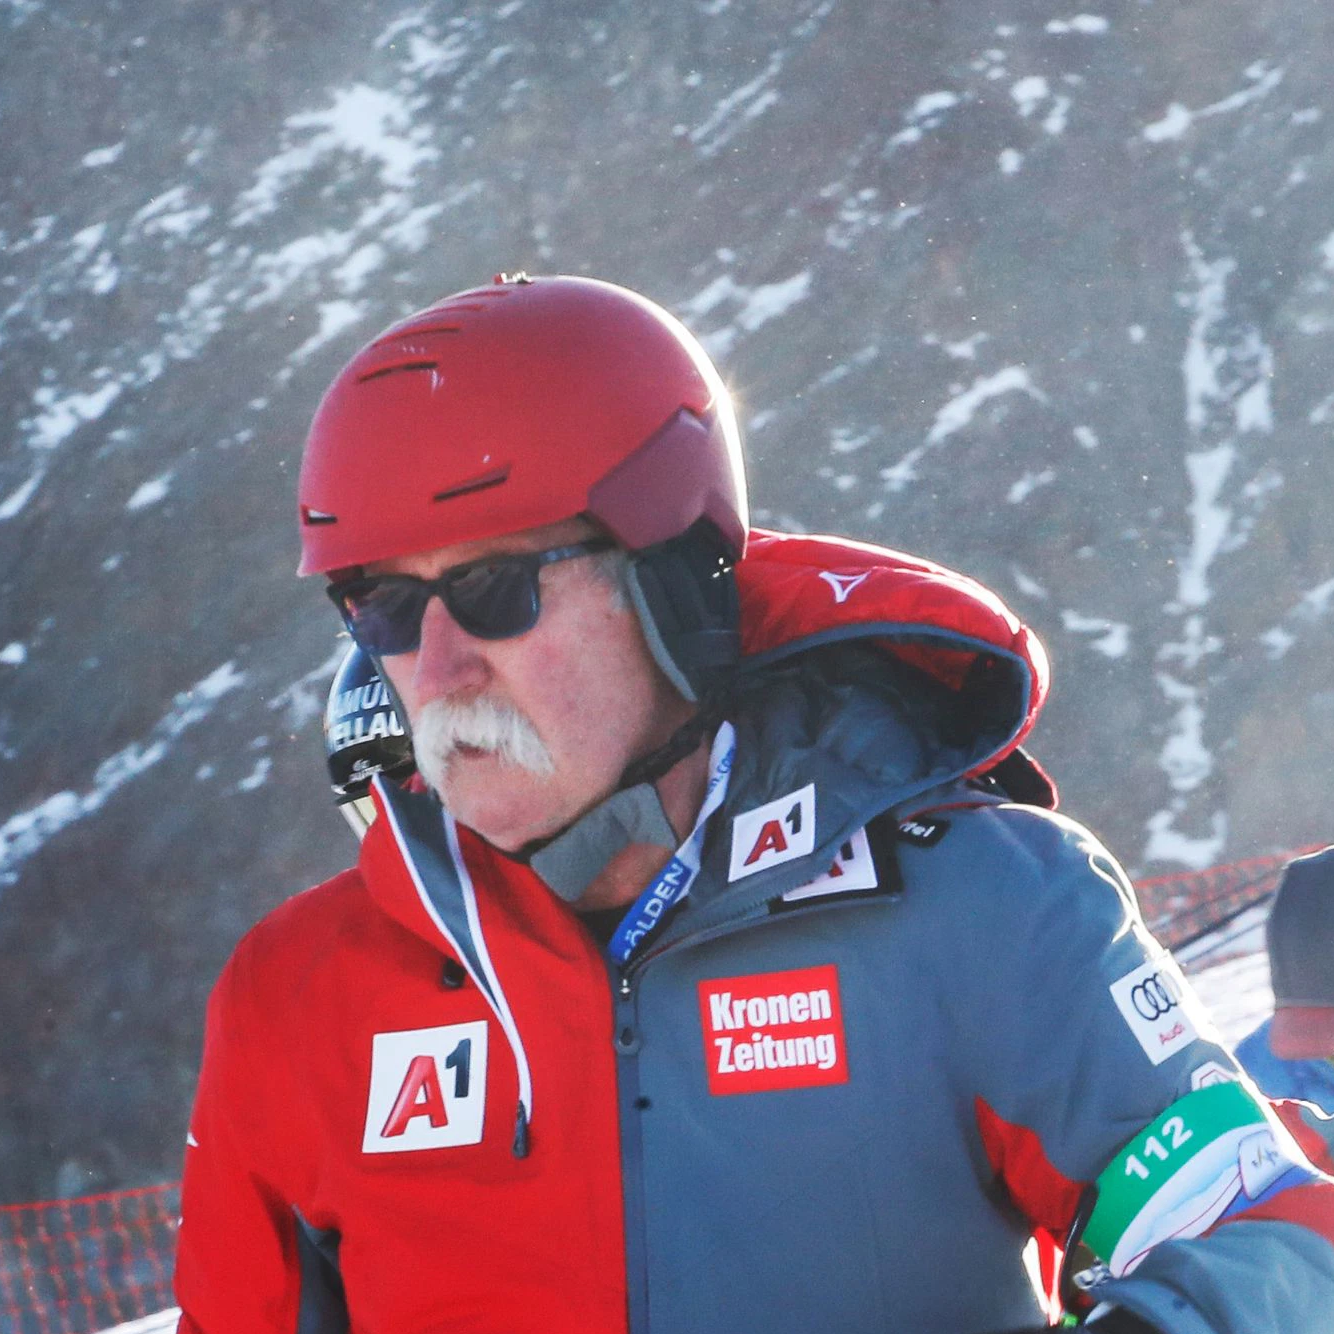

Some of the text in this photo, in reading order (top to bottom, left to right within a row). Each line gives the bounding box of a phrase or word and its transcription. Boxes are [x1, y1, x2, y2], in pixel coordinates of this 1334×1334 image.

[743, 801, 803, 867] A1
[709, 988, 833, 1032] Kronen
[713, 1031, 838, 1075] Zeitung
[380, 1037, 472, 1138] A1
[1124, 1115, 1194, 1181] 112
